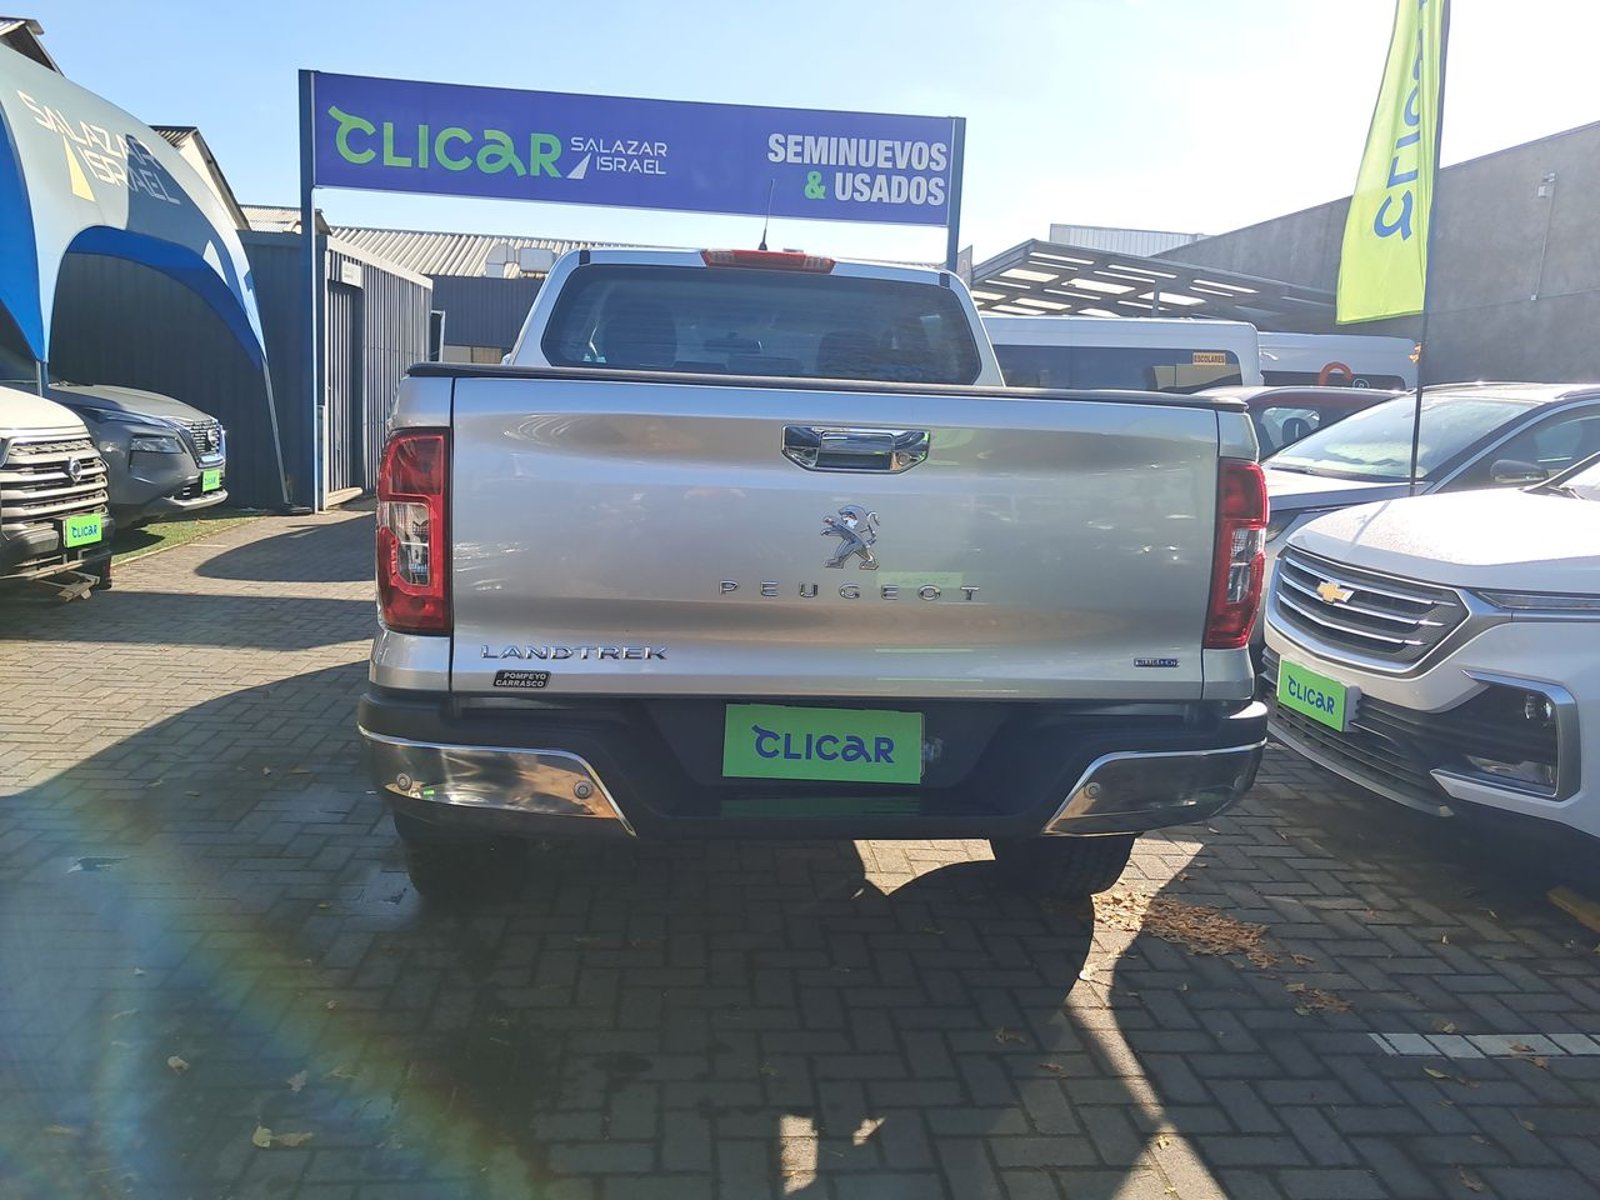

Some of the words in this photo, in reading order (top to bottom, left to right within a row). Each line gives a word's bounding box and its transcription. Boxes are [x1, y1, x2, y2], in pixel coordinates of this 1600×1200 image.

[17, 89, 161, 170] SALAZAR
[570, 136, 668, 157] SALAZAR
[767, 133, 947, 171] SEMINUEVOS
[77, 145, 181, 205] ISRAEL
[596, 156, 667, 175] ISRAEL
[804, 170, 827, 200] &
[834, 172, 946, 206] USADOS
[719, 580, 981, 601] PEUGEOT
[480, 645, 668, 660] LANDTREK
[495, 679, 544, 687] CARRASCO
[503, 672, 547, 680] POMPEYO
